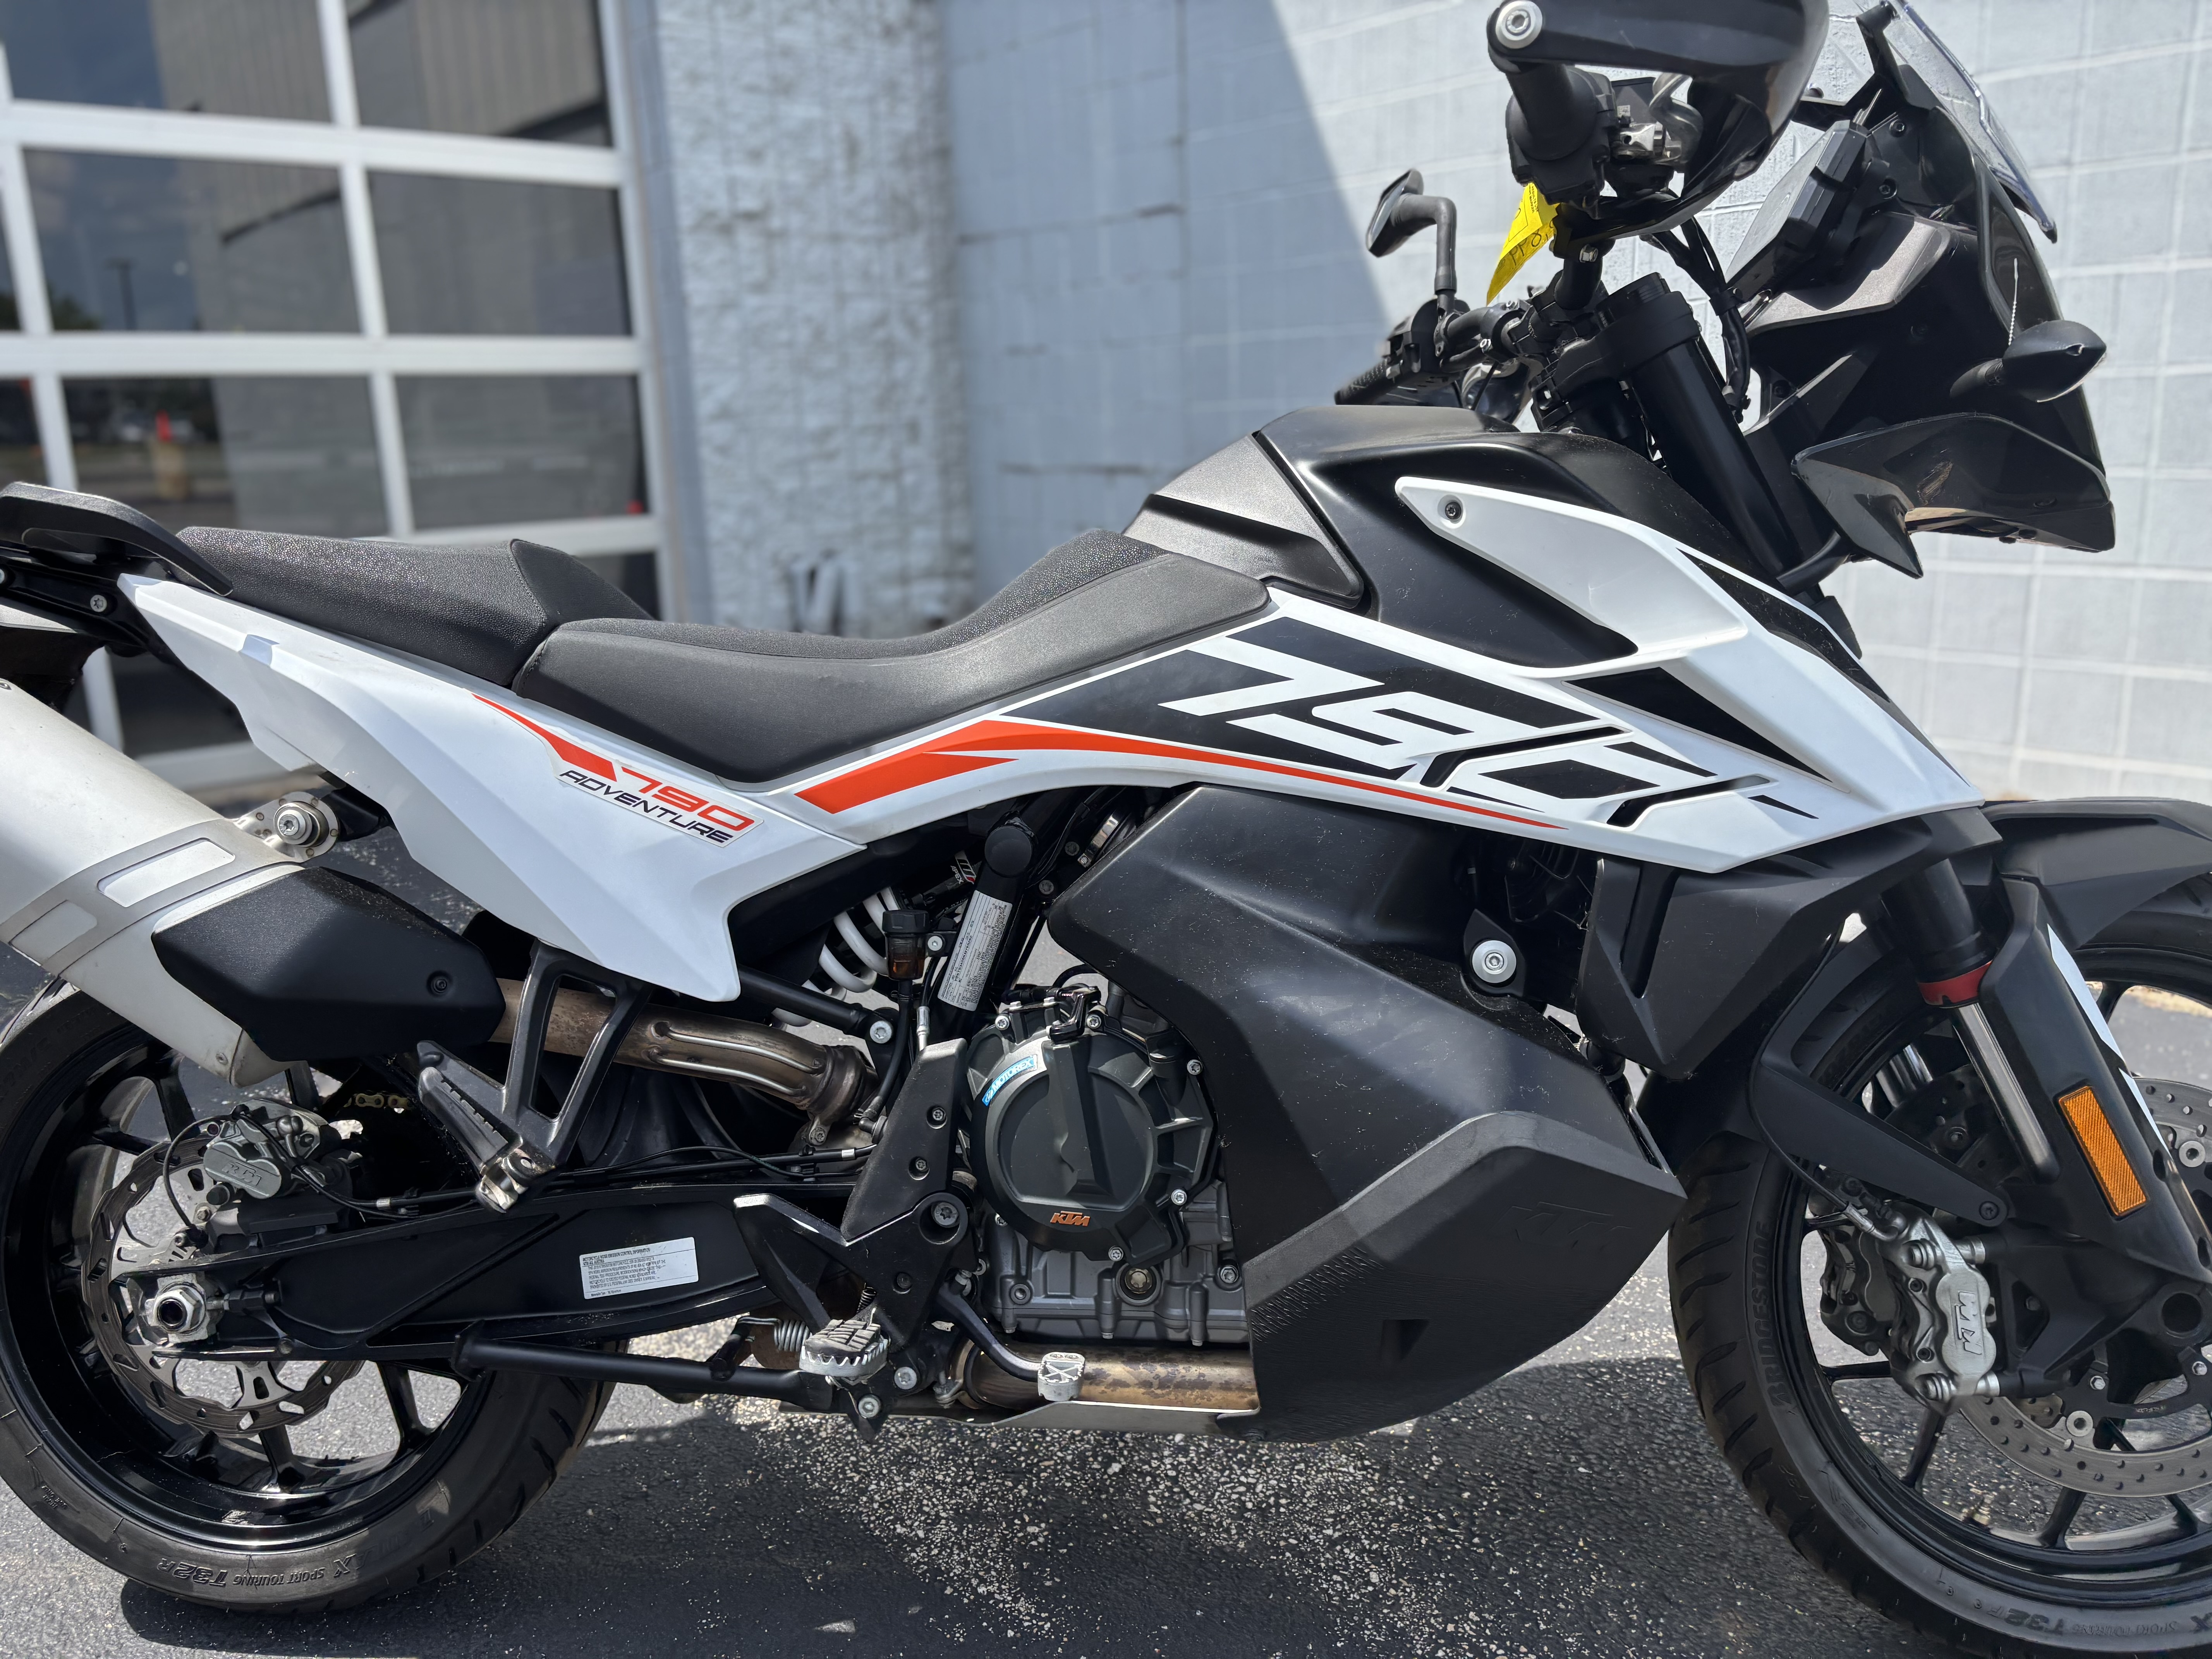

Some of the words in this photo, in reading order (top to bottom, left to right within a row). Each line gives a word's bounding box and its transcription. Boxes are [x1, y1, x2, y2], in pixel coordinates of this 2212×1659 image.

[559, 769, 734, 844] ADVENTURE
[622, 767, 754, 831] 790
[950, 866, 964, 884] APEX
[991, 1057, 1034, 1092] MOTOREX
[1050, 1211, 1091, 1226] KTM
[1751, 1221, 1794, 1408] BRIDGESTONE
[232, 1573, 284, 1587] TOURING
[285, 1566, 326, 1585] SPORT
